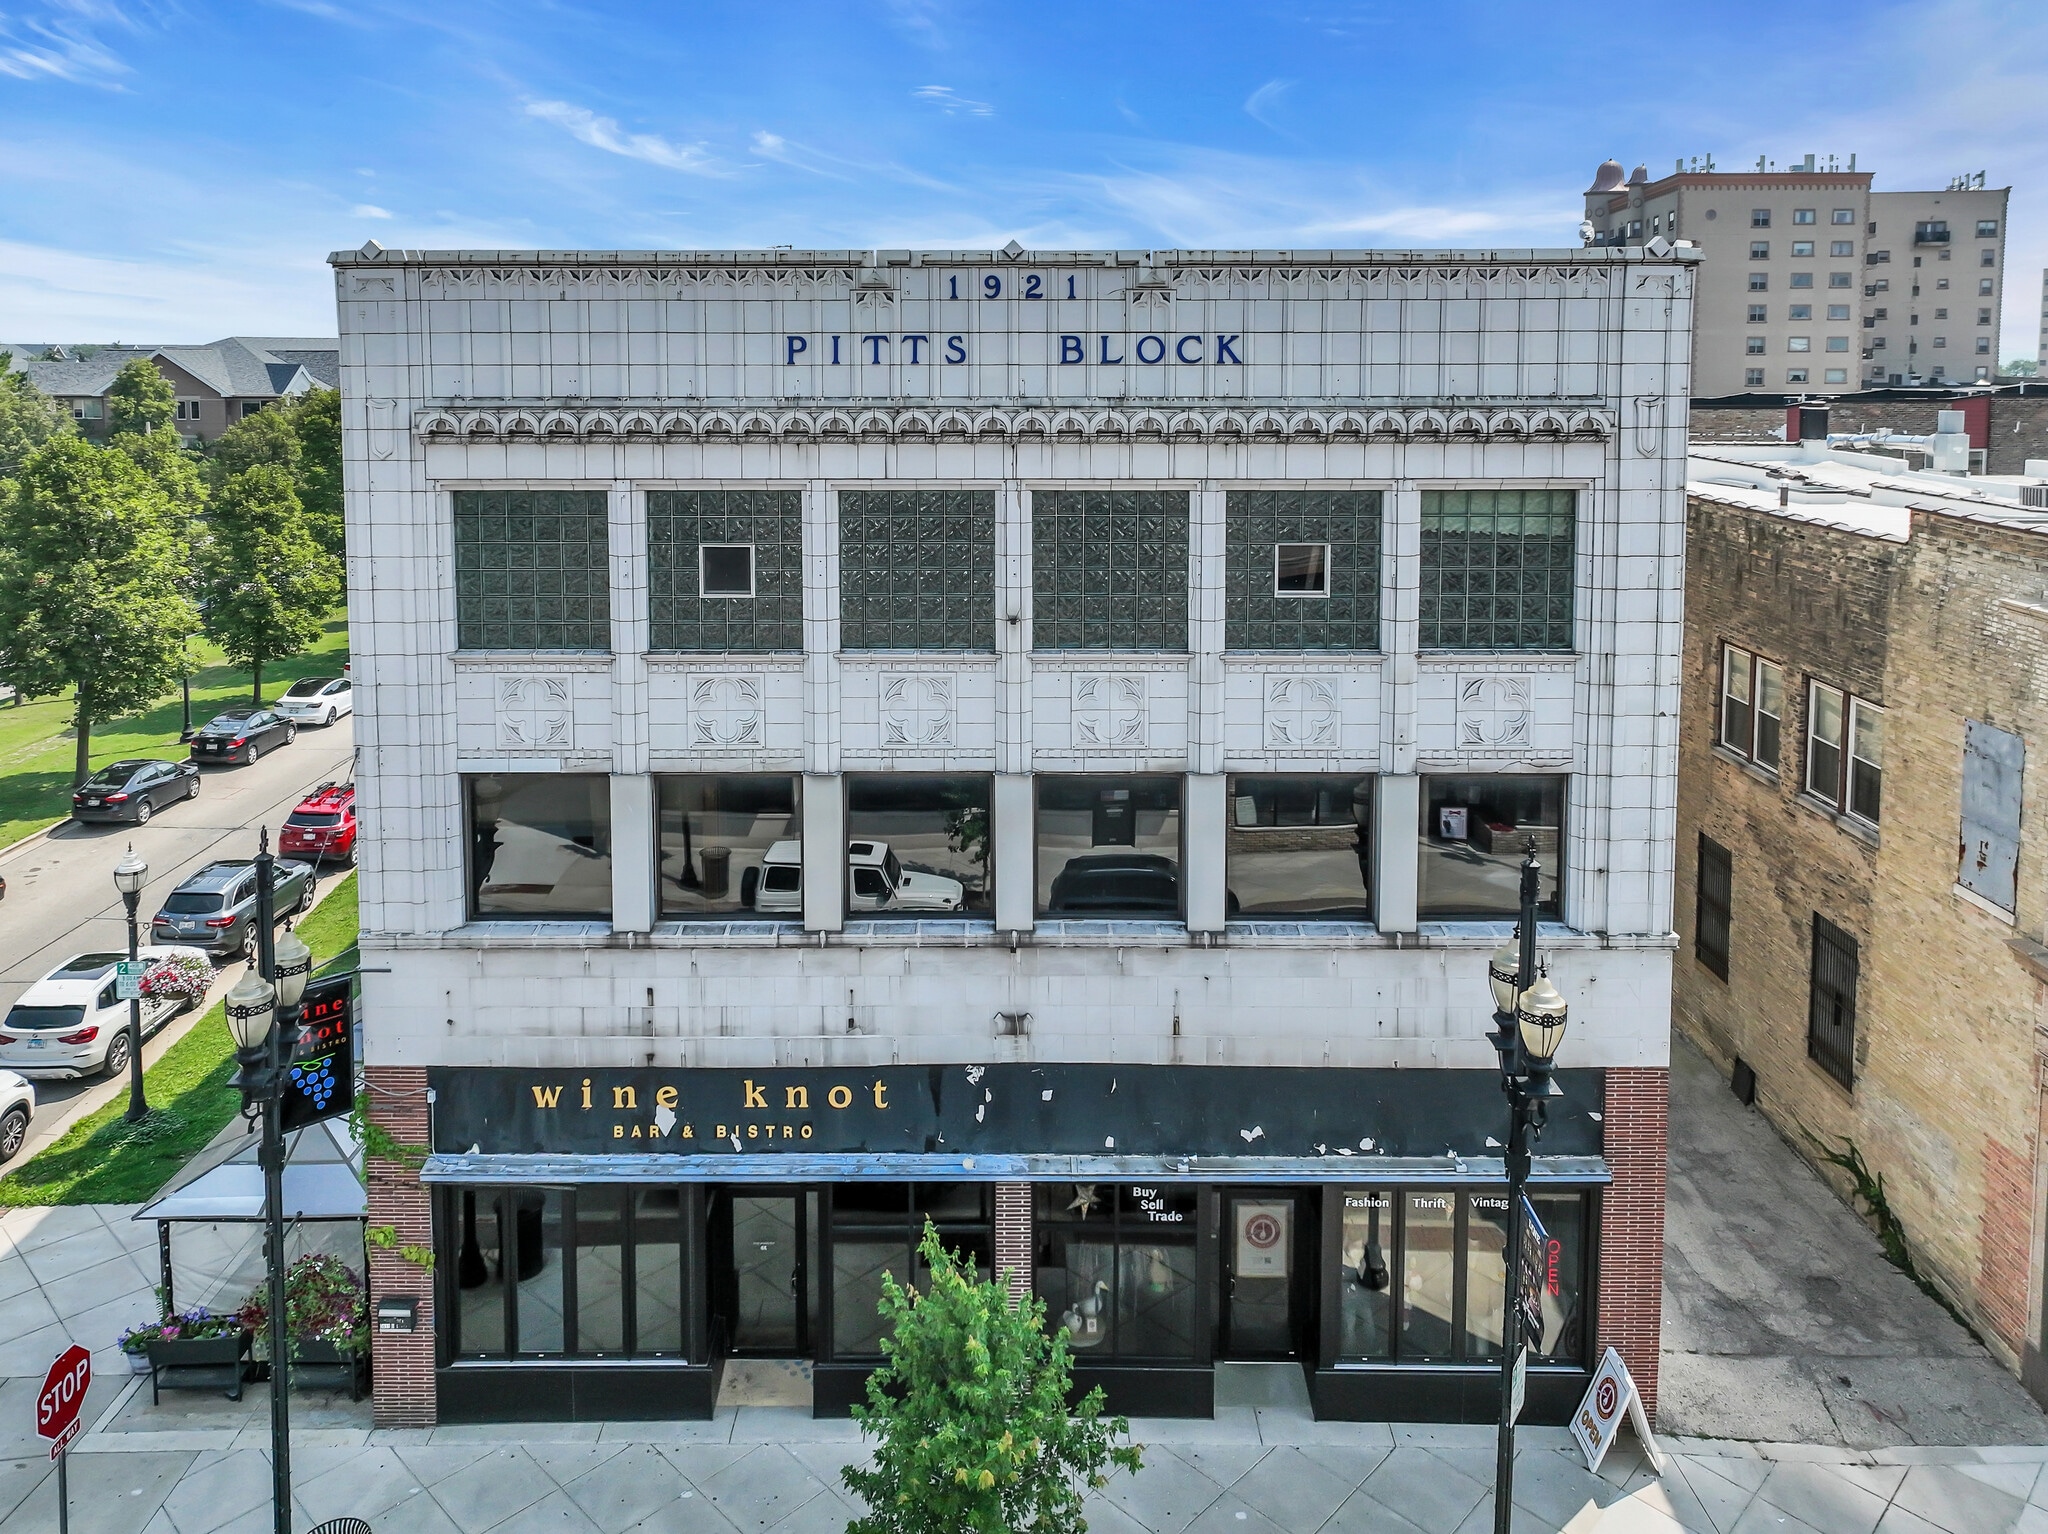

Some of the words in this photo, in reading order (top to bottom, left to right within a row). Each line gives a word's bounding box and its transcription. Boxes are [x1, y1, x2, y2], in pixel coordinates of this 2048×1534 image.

[948, 274, 1077, 300] 1921
[786, 335, 966, 366] PITTS
[1060, 334, 1243, 366] BLOCK
[119, 963, 126, 974] 2
[303, 999, 343, 1019] ine
[299, 1021, 343, 1044] not
[310, 1037, 346, 1052] BISTRO
[531, 1078, 679, 1109] wine
[743, 1079, 889, 1110] knot
[612, 1125, 660, 1138] BAR
[682, 1125, 694, 1138] &
[716, 1125, 813, 1139] BISTRO
[1133, 1186, 1157, 1199] Buy
[1140, 1199, 1164, 1210] Sell
[1345, 1197, 1390, 1208] Fashion
[1412, 1198, 1447, 1208] Thrift
[1470, 1197, 1509, 1210] Vintag
[1148, 1211, 1183, 1222] Trade
[1547, 1239, 1561, 1297] OPEN
[40, 1358, 88, 1425] STOP
[1581, 1409, 1603, 1450] OPEN
[53, 1439, 65, 1457] ALL
[66, 1421, 79, 1438] WAY
